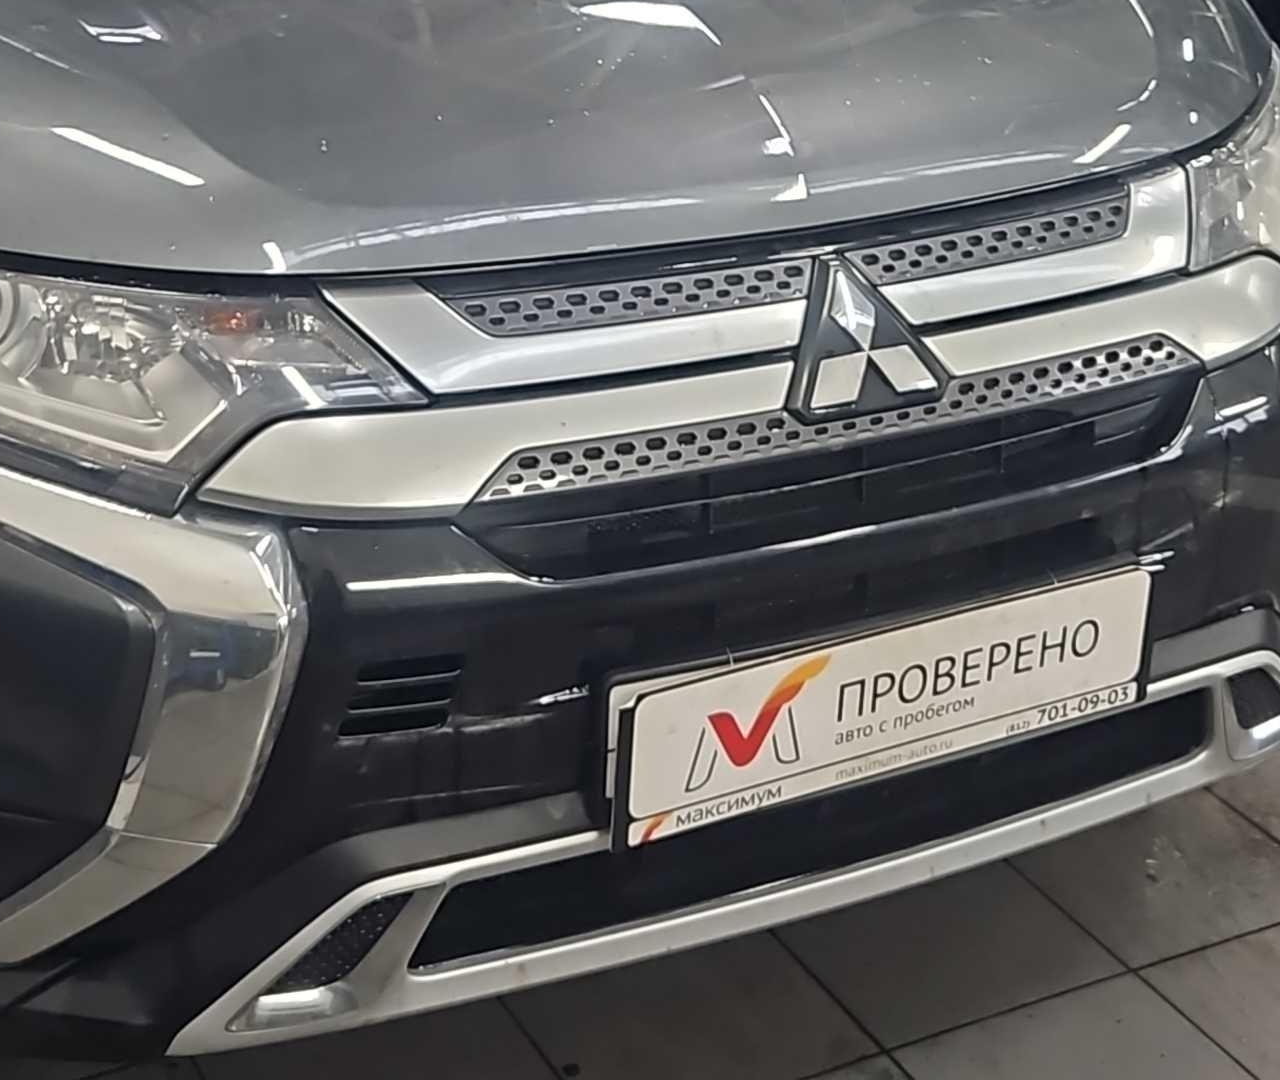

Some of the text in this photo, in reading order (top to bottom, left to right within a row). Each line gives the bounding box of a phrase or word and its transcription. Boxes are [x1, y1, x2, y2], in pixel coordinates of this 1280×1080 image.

[836, 619, 1100, 722] ПРОВЕРЕНО
[834, 696, 976, 746] авто с пробегом
[1036, 686, 1129, 725] 701-09-03
[834, 737, 954, 782] maximum-auto.ru
[675, 785, 783, 829] максимум
